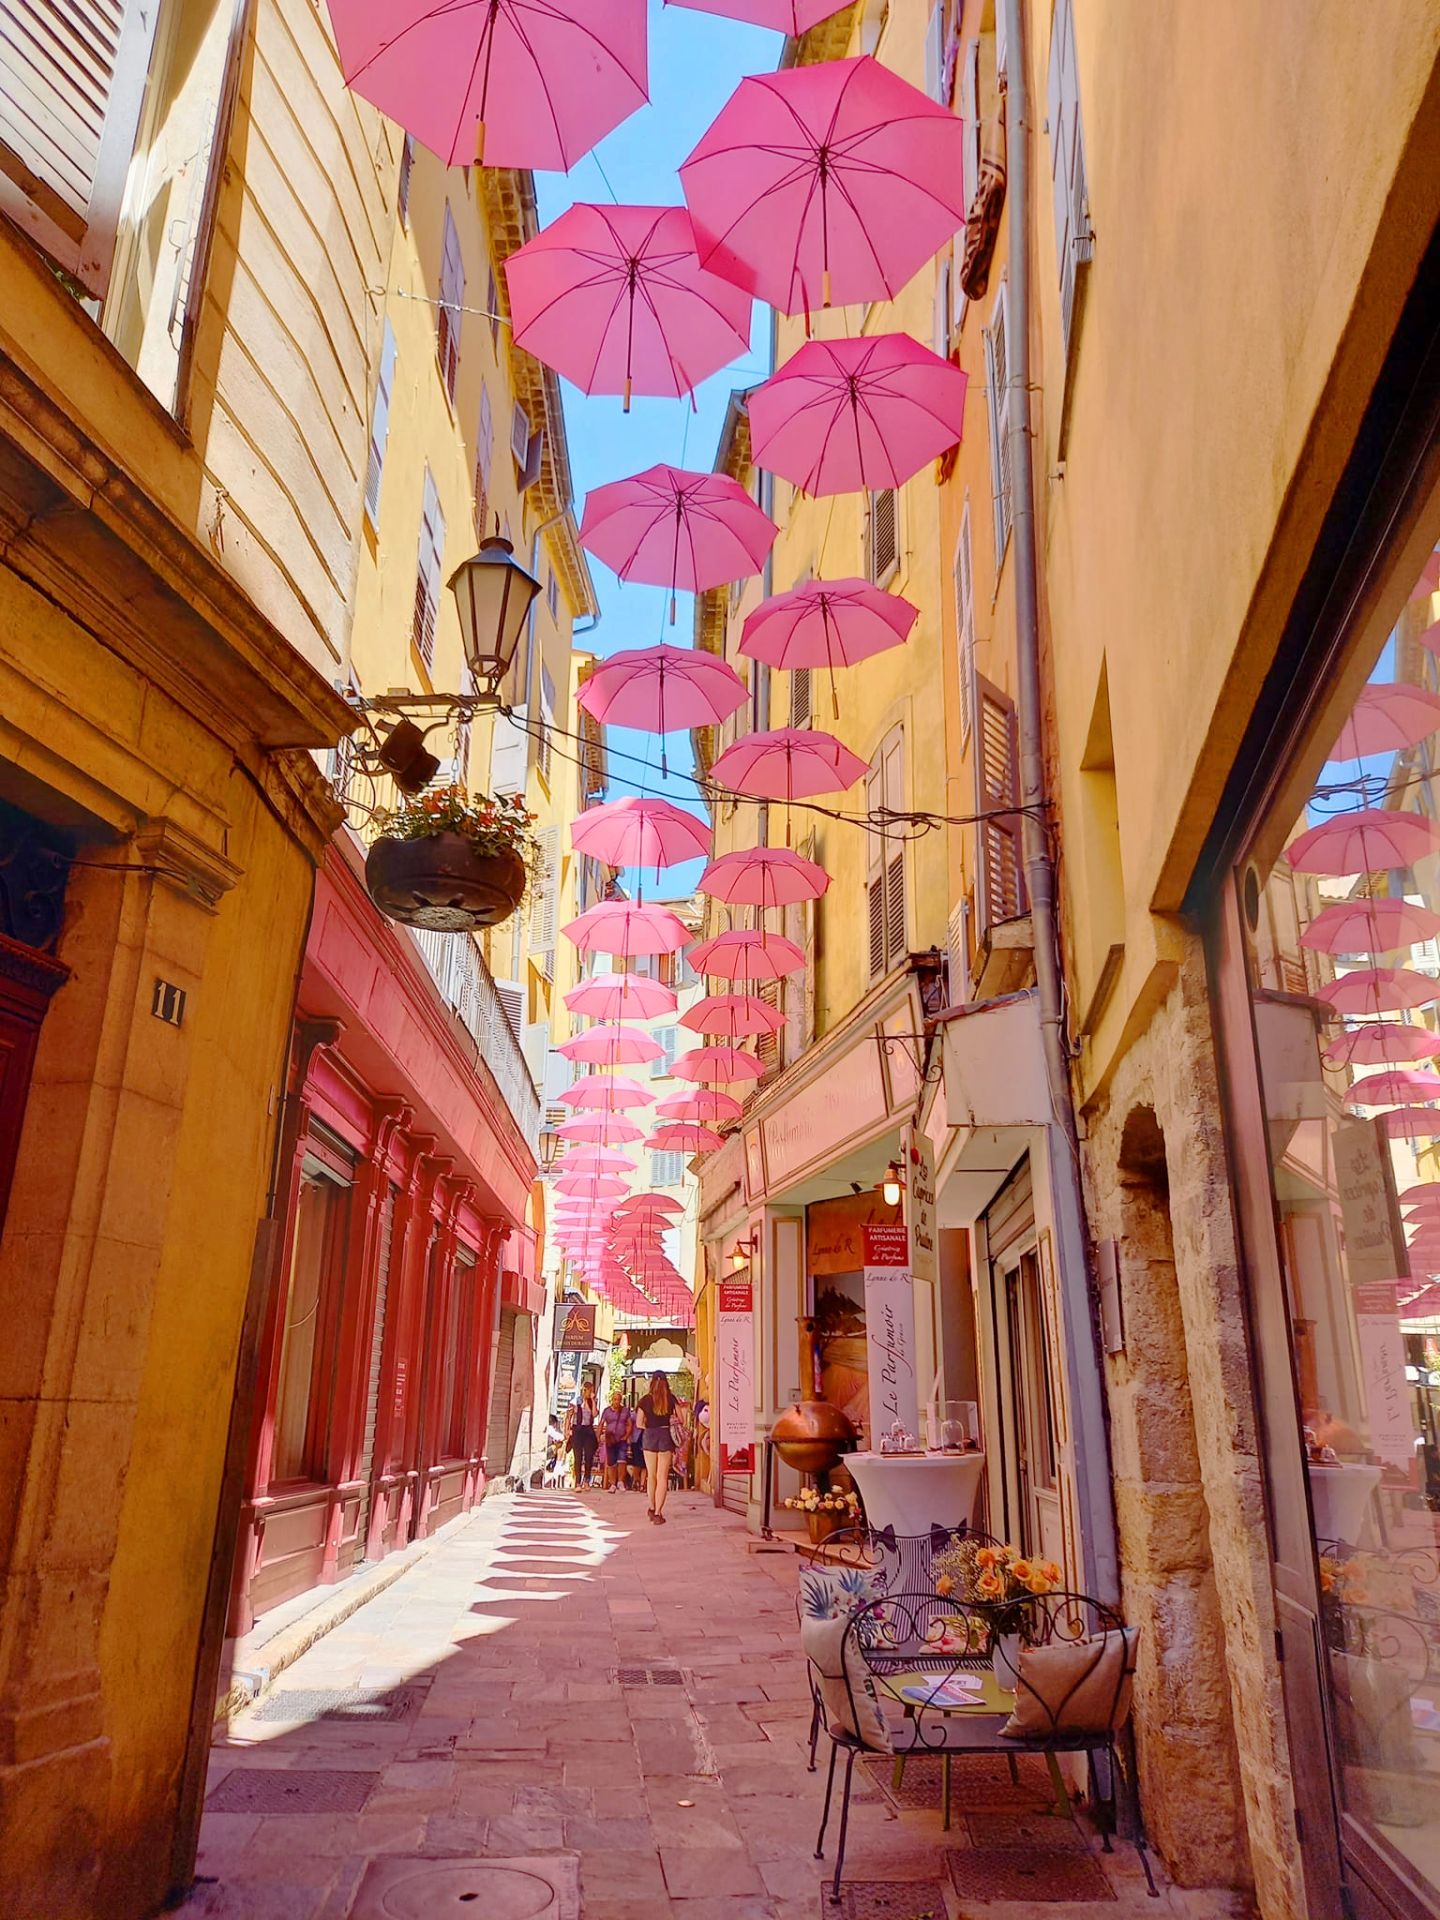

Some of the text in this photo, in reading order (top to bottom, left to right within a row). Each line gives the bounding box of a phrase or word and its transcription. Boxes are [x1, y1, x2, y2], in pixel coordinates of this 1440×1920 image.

[154, 982, 182, 1025] 11
[919, 1155, 929, 1181] Les
[912, 1176, 934, 1207] Caprices
[920, 1209, 927, 1226] de
[869, 1234, 906, 1242] ARTISANALE
[914, 1224, 933, 1252] Pauline
[871, 1304, 913, 1384] Parfumoir
[722, 1338, 751, 1392] Parfumoir
[729, 1395, 740, 1412] Le
[882, 1391, 899, 1416] Le
